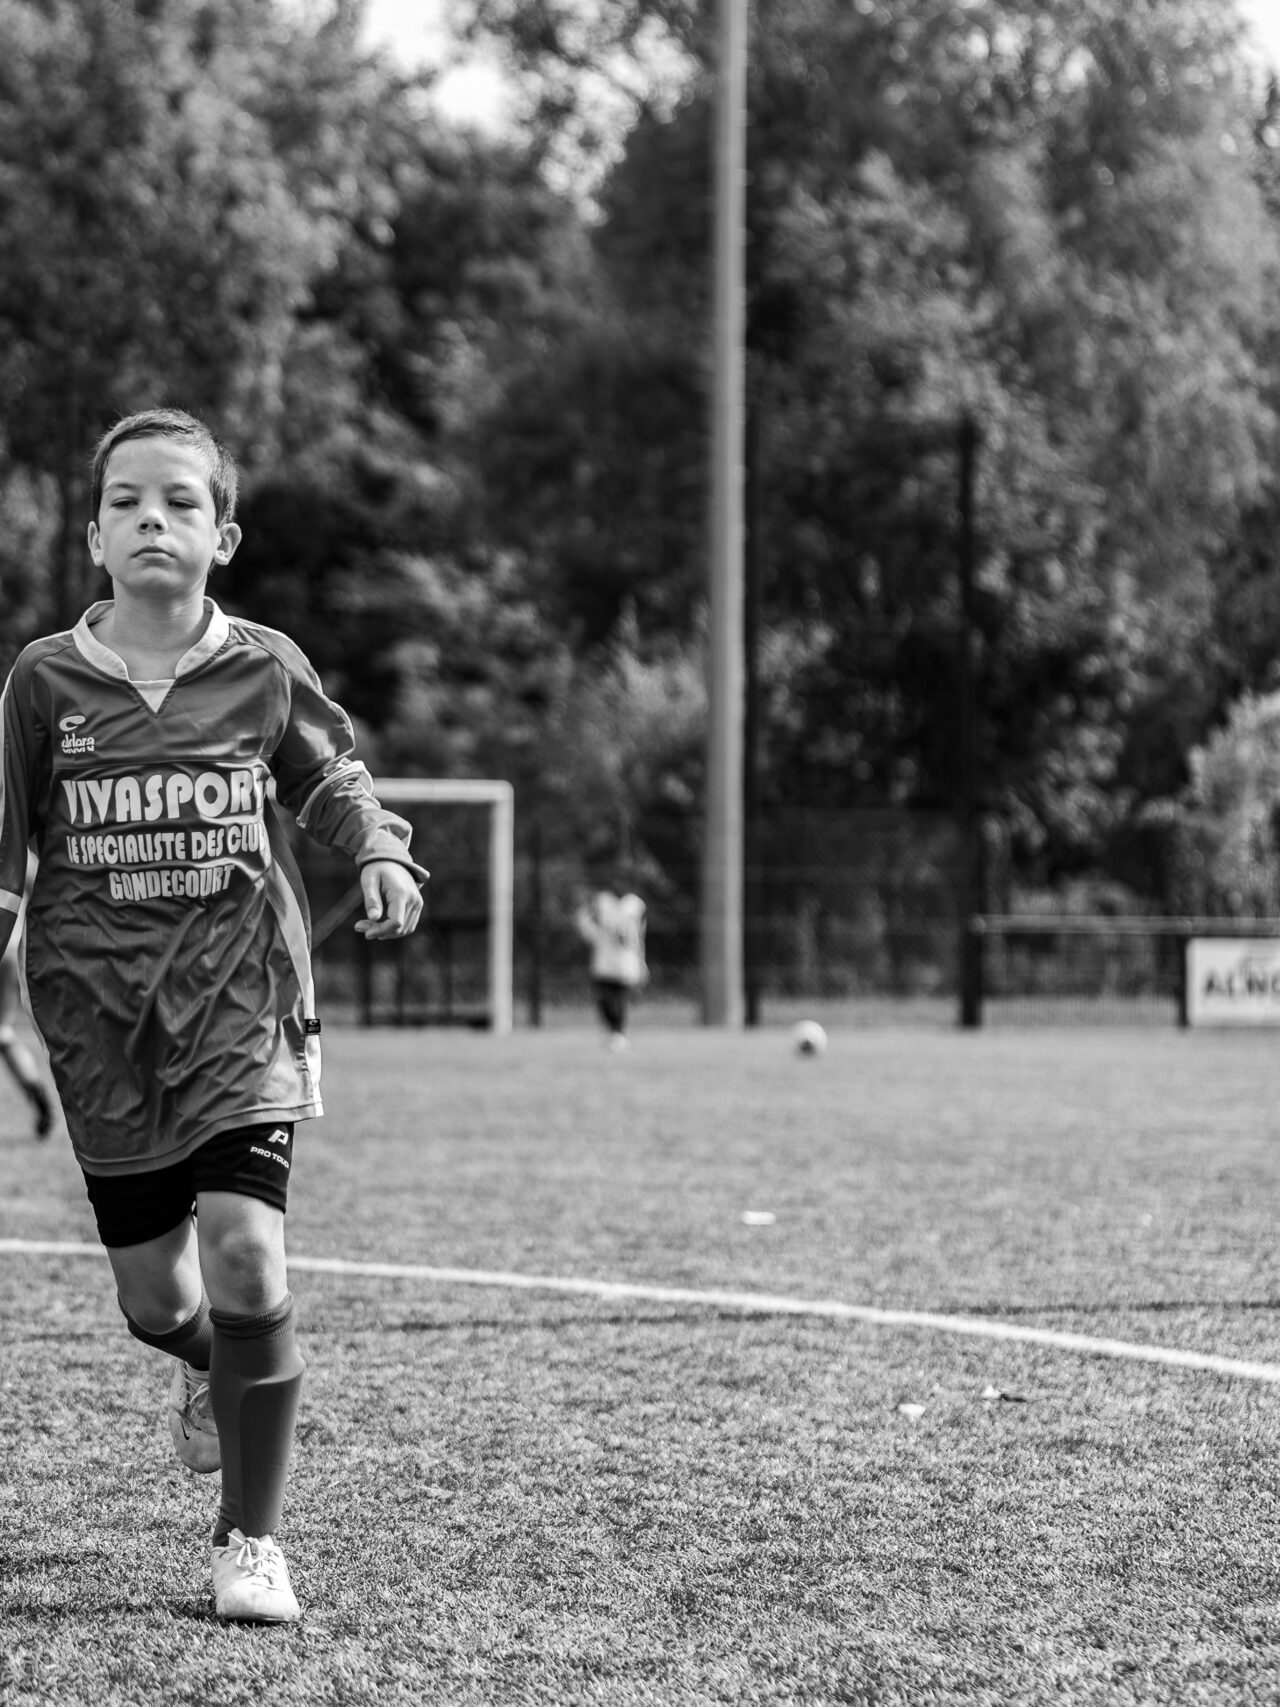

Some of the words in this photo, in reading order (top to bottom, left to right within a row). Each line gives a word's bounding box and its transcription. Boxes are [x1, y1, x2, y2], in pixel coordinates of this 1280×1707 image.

[80, 832, 186, 865] SPECIALISTE
[191, 828, 225, 860] DES
[108, 864, 235, 901] GONDECOURT
[250, 1146, 271, 1158] PRO
